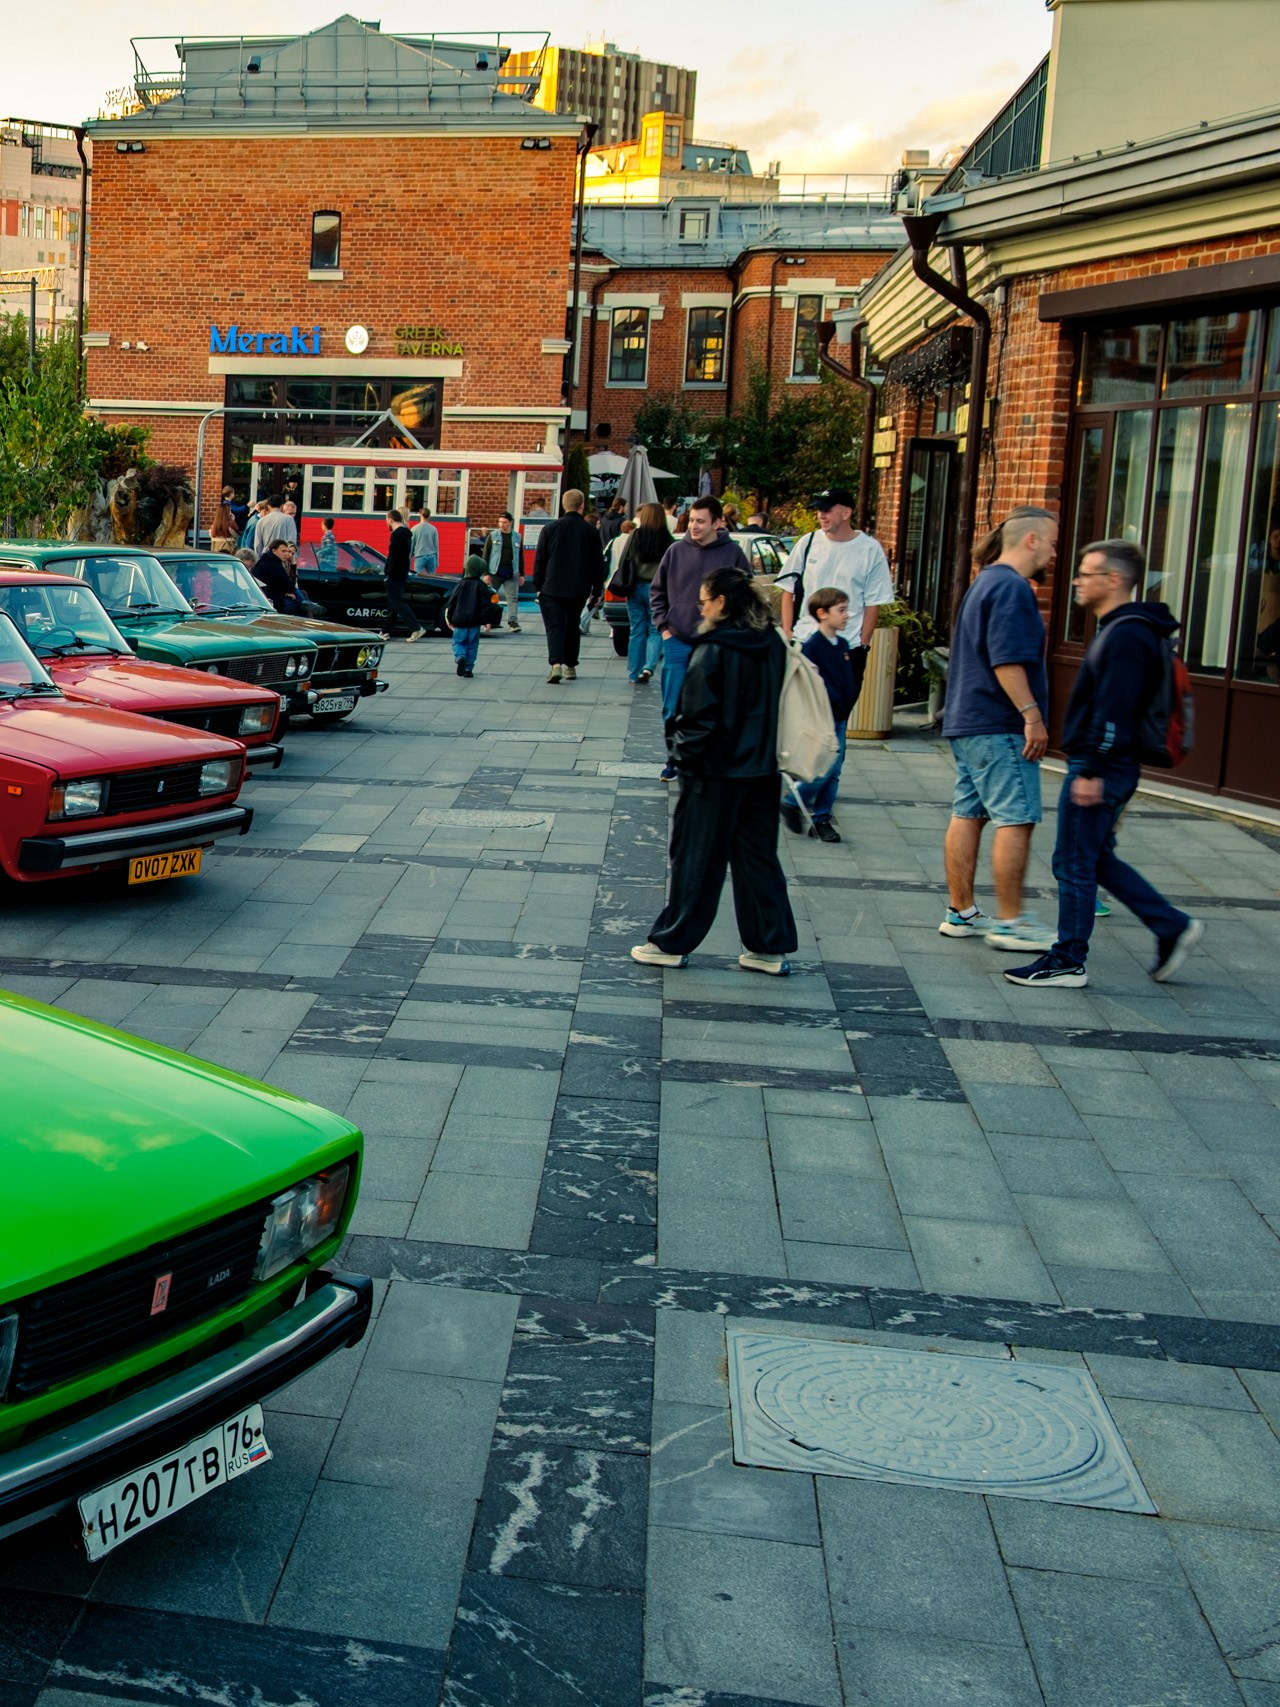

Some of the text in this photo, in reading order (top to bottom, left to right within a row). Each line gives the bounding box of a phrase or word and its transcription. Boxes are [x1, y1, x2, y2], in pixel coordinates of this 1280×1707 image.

[210, 325, 320, 354] Meraki
[394, 327, 444, 340] GREEK
[395, 342, 464, 355] TAVERNA
[347, 607, 388, 618] CARFAC
[134, 852, 197, 879] OV07 ZXK
[209, 1268, 231, 1287] LADA
[227, 1415, 253, 1458] 76
[227, 1452, 249, 1474] RUS
